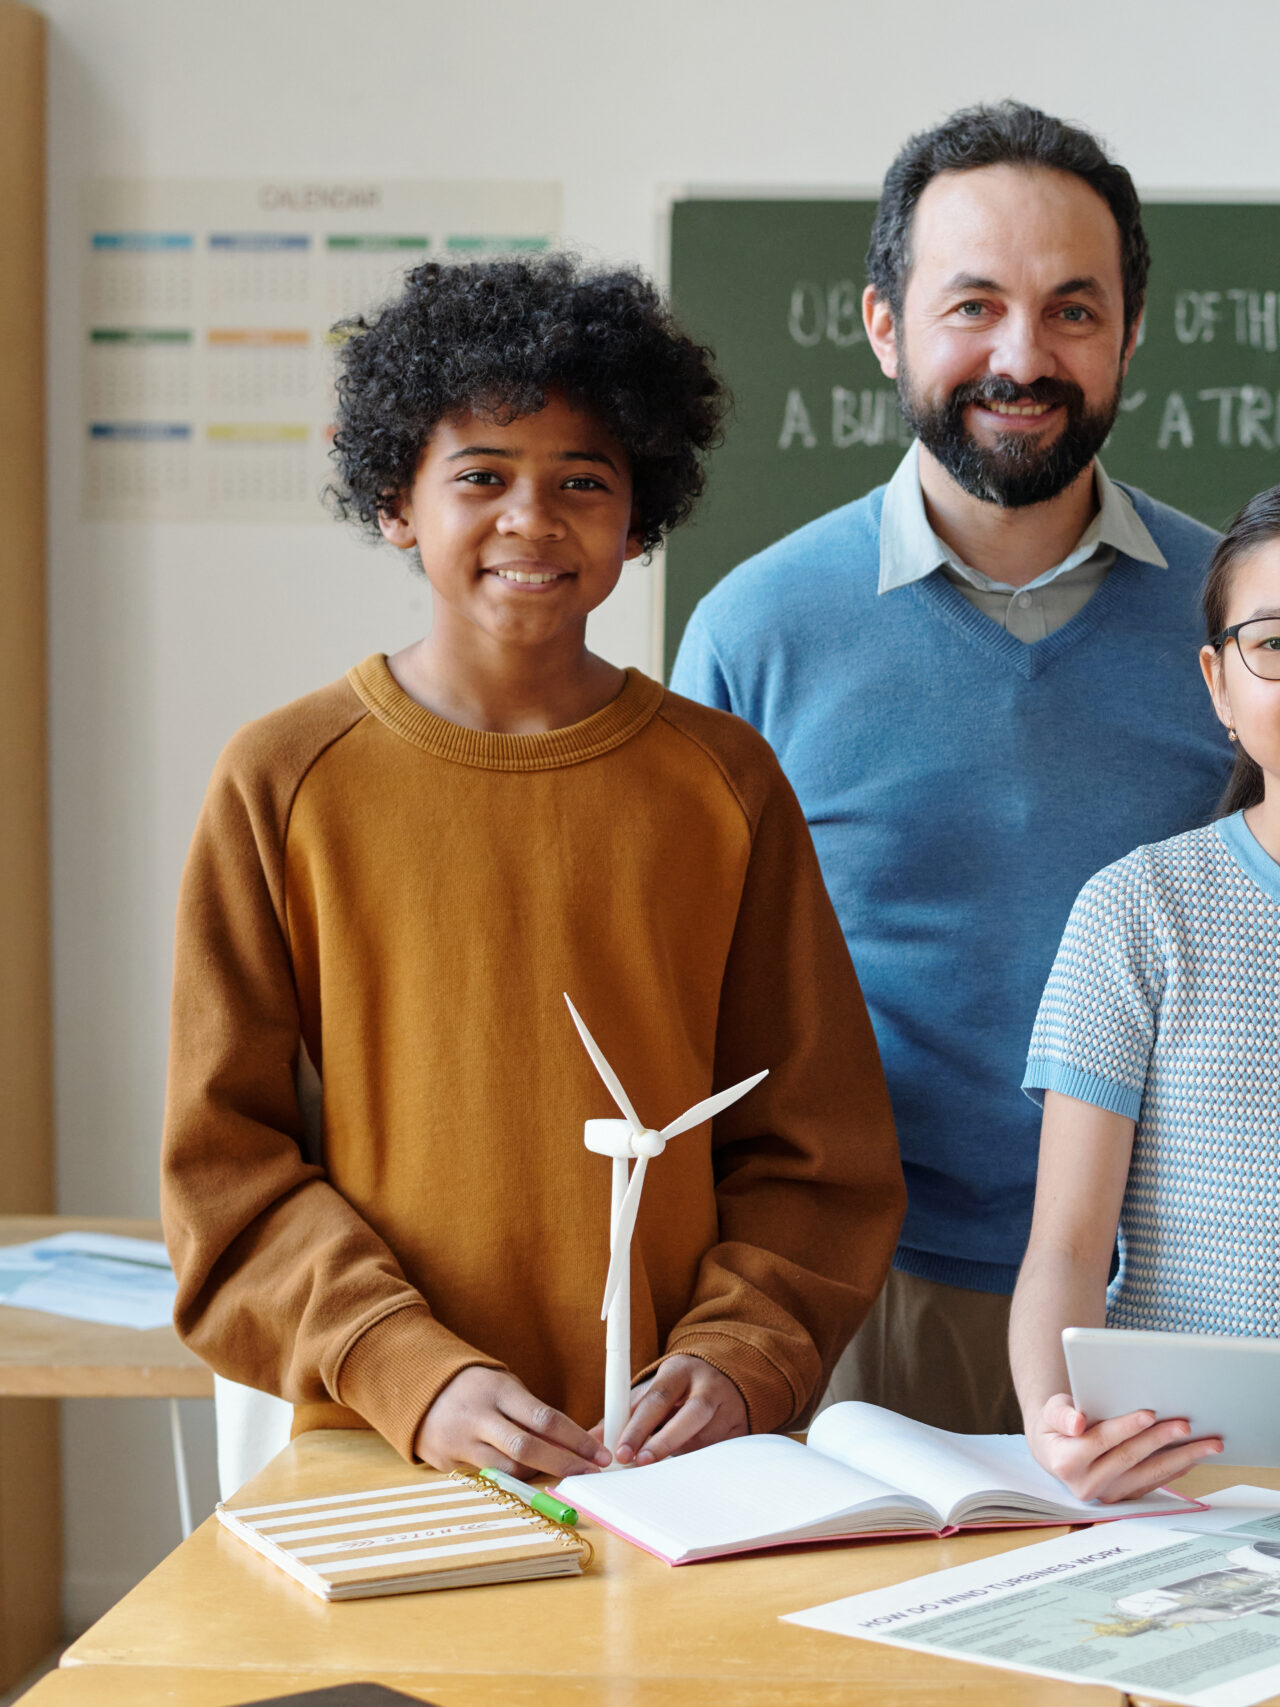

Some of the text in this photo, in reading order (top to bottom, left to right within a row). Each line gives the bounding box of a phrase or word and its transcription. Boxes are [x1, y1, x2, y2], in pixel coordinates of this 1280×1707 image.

[259, 184, 381, 212] CALENDAR
[1175, 290, 1222, 344] OF
[778, 388, 817, 449] A
[1157, 392, 1193, 449] A
[858, 1611, 909, 1629] HOW
[906, 1602, 939, 1615] DO
[939, 1587, 988, 1606] WIND
[985, 1563, 1076, 1590] TURBINES
[1074, 1546, 1131, 1566] WORK
